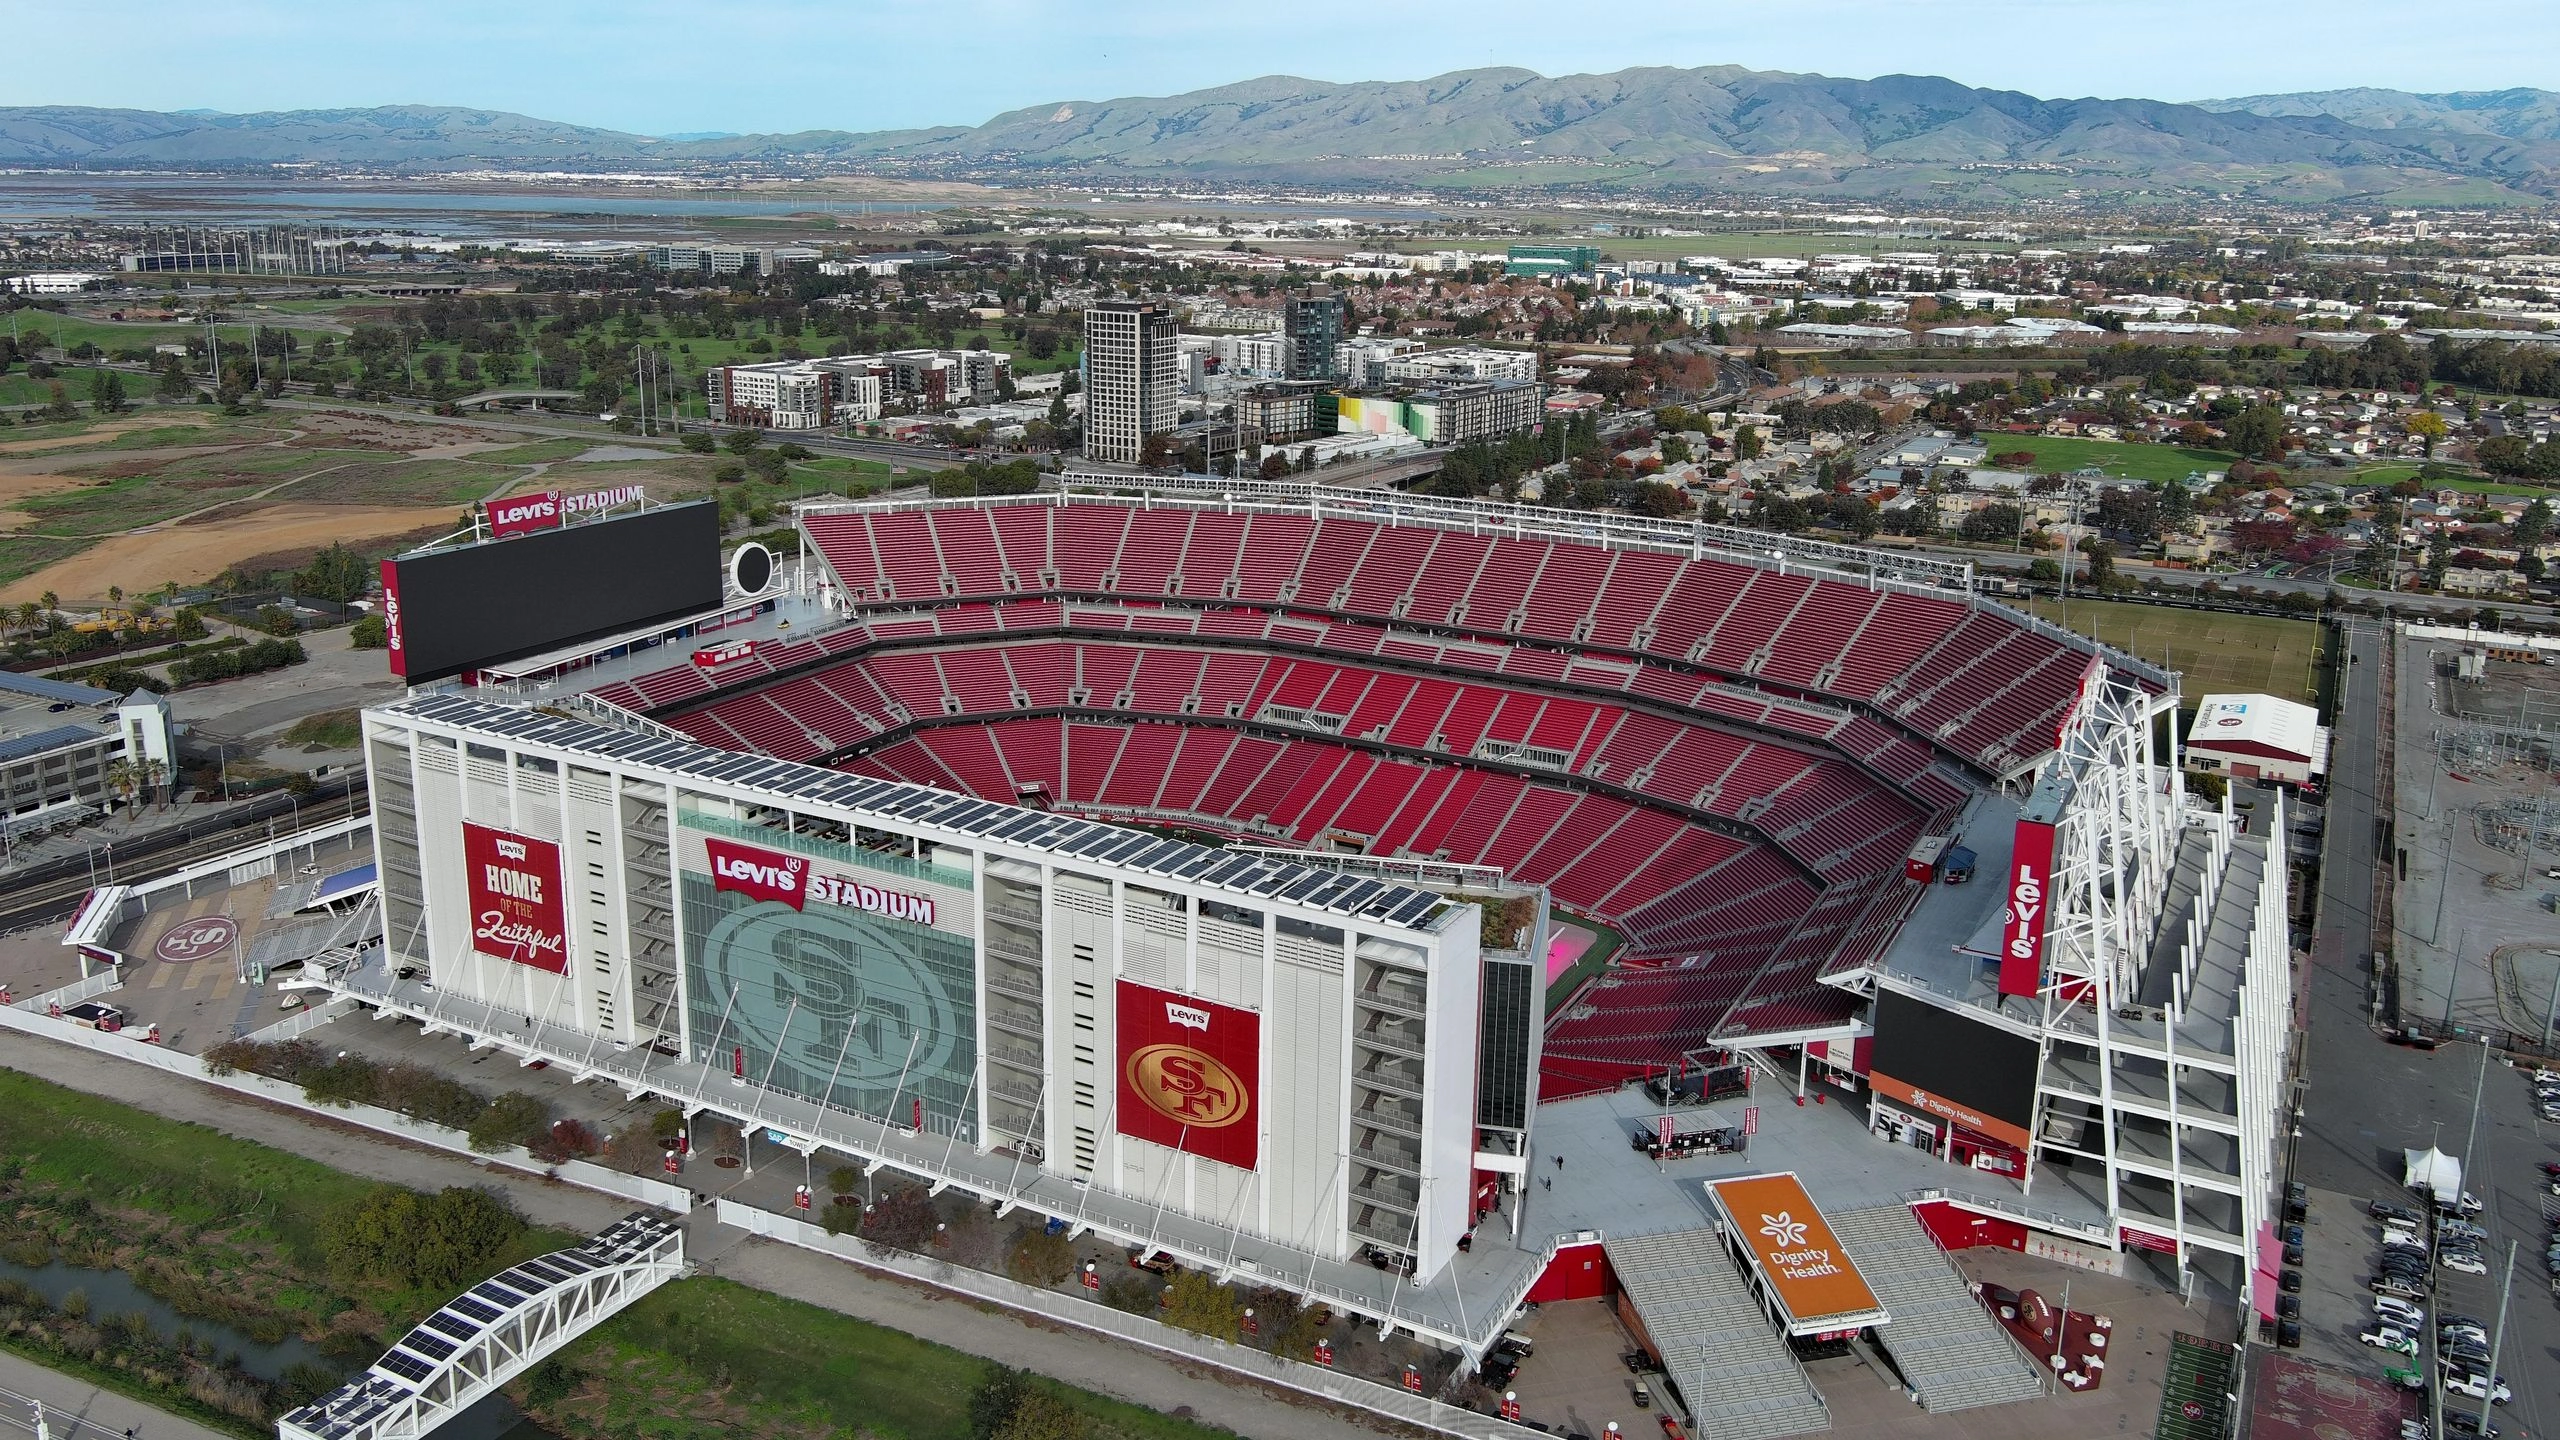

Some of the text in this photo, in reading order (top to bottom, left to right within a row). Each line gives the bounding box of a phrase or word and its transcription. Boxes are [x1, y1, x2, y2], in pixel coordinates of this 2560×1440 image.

[563, 485, 642, 513] STADIUM
[500, 844, 524, 856] Levi's
[485, 863, 544, 904] HOME
[716, 855, 934, 925] Levi's STADIUM
[500, 897, 533, 918] OF THE
[476, 910, 563, 959] Faithful
[1171, 1008, 1205, 1024] Levi's
[1160, 1055, 1227, 1119] SF
[1929, 1099, 1983, 1127] Dignity Health
[767, 1132, 783, 1143] SAP
[1769, 1248, 1829, 1266] Dignity
[1781, 1261, 1839, 1280] Health
